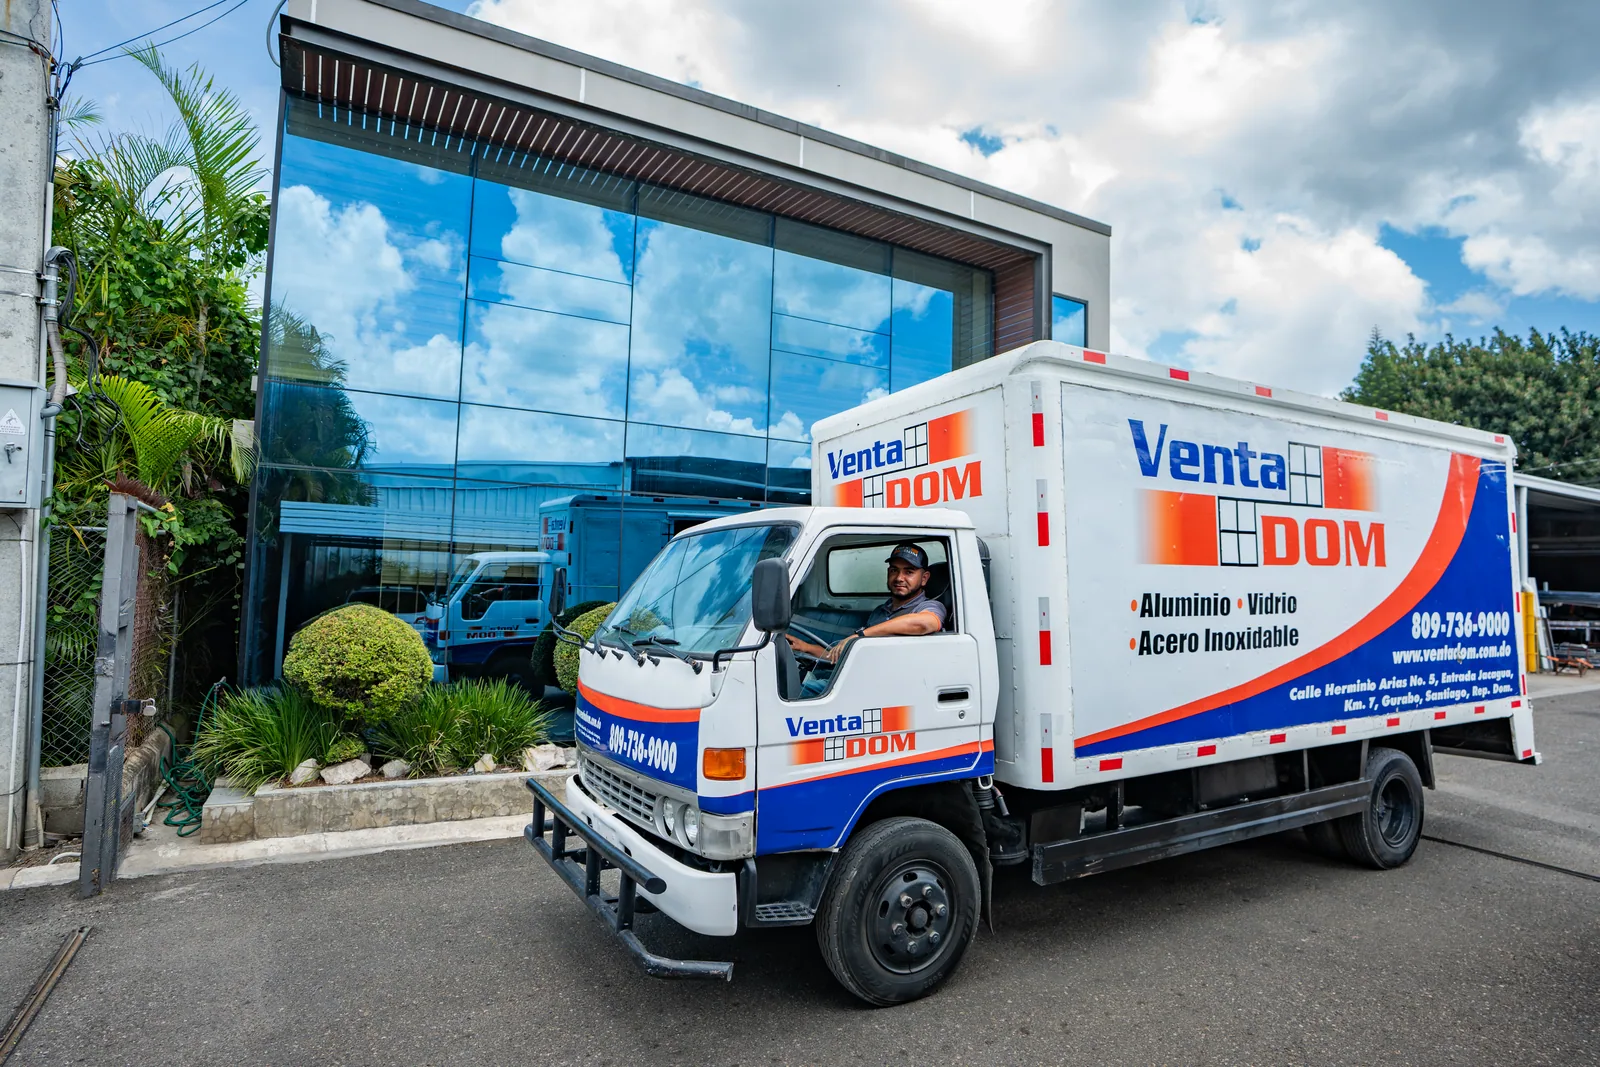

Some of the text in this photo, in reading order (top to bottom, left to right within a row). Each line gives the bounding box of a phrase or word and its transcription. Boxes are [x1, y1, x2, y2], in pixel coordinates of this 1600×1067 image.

[828, 439, 903, 480] Venta
[1128, 419, 1286, 491] Venta
[886, 461, 982, 508] DOM
[1262, 515, 1386, 567] DOM
[1140, 592, 1297, 618] Aluminio Vidrio
[1138, 625, 1299, 656] Acero Inoxidable
[1411, 611, 1510, 640] 809-736-9000
[1392, 640, 1511, 664] www.ventadom.com.do
[1289, 669, 1514, 701] Calle Herminio Arias No. 5, Entrada Jacagua,
[1344, 683, 1513, 712] Km. 7, Gurabo, Santiago, Rep. Dom.
[785, 714, 862, 737] Venta
[609, 723, 677, 774] 809-736-9000
[846, 732, 917, 758] DOM
